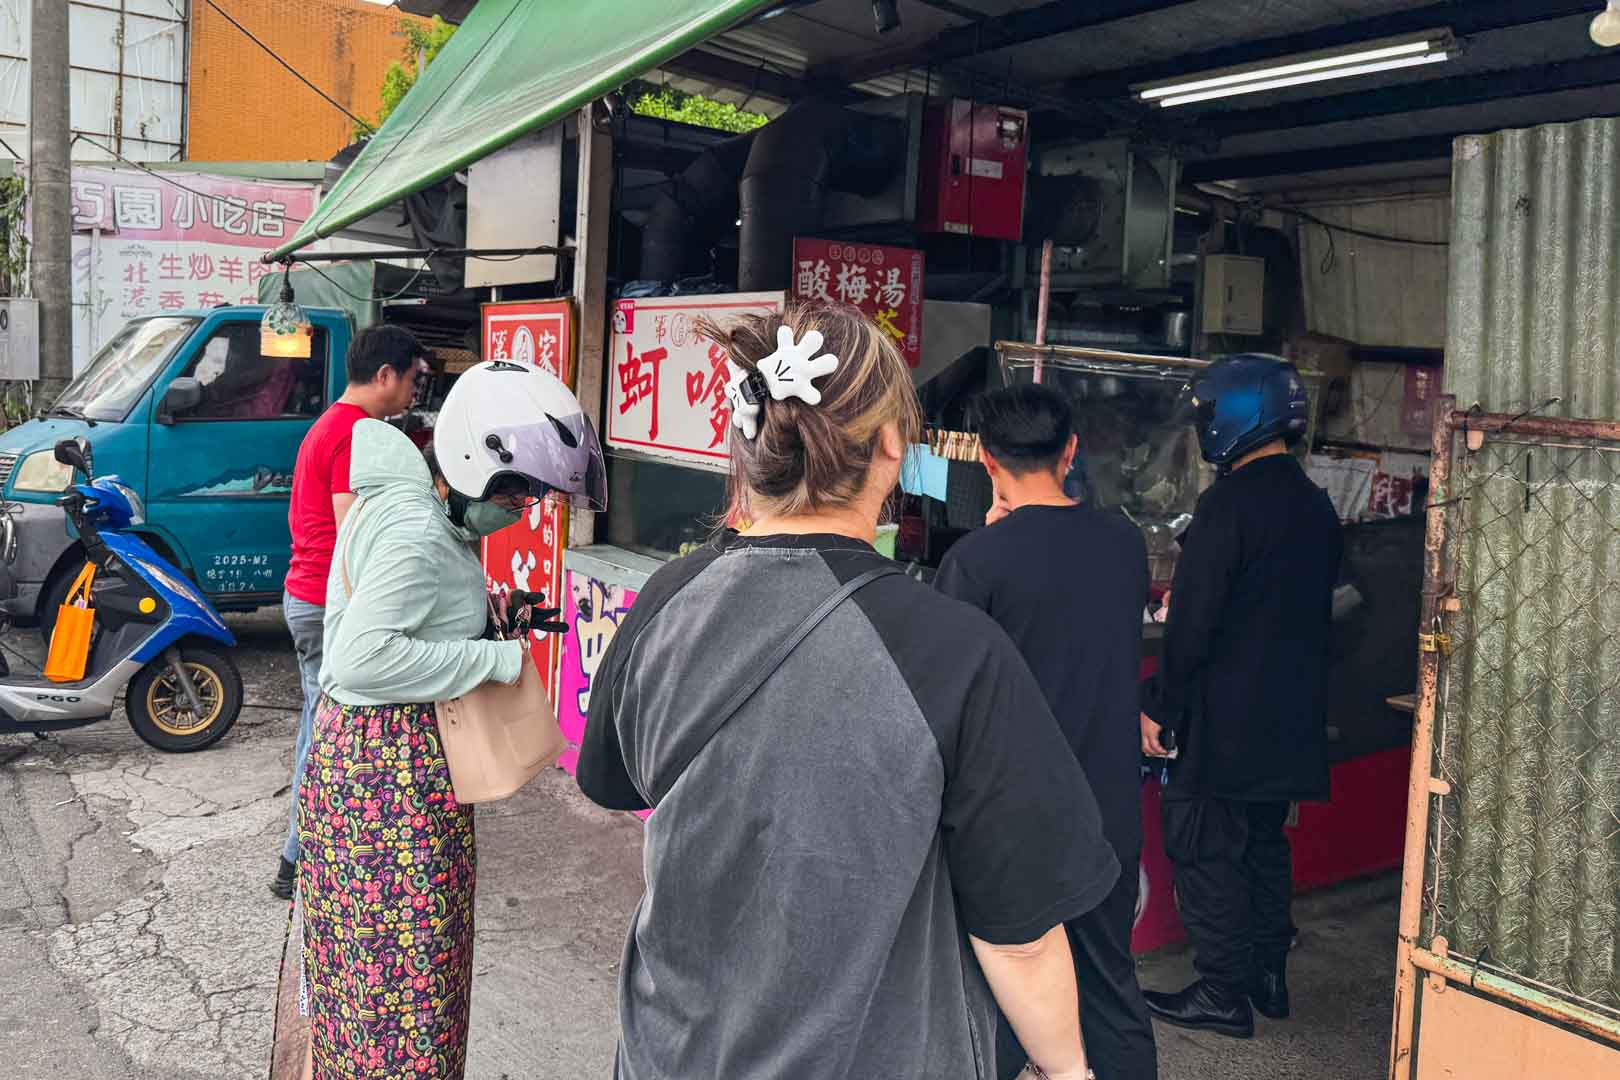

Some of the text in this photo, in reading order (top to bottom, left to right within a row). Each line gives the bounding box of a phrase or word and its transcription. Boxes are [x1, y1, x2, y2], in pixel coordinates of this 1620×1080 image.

[798, 260, 906, 308] 酸梅湯
[37, 694, 81, 703] PGO
